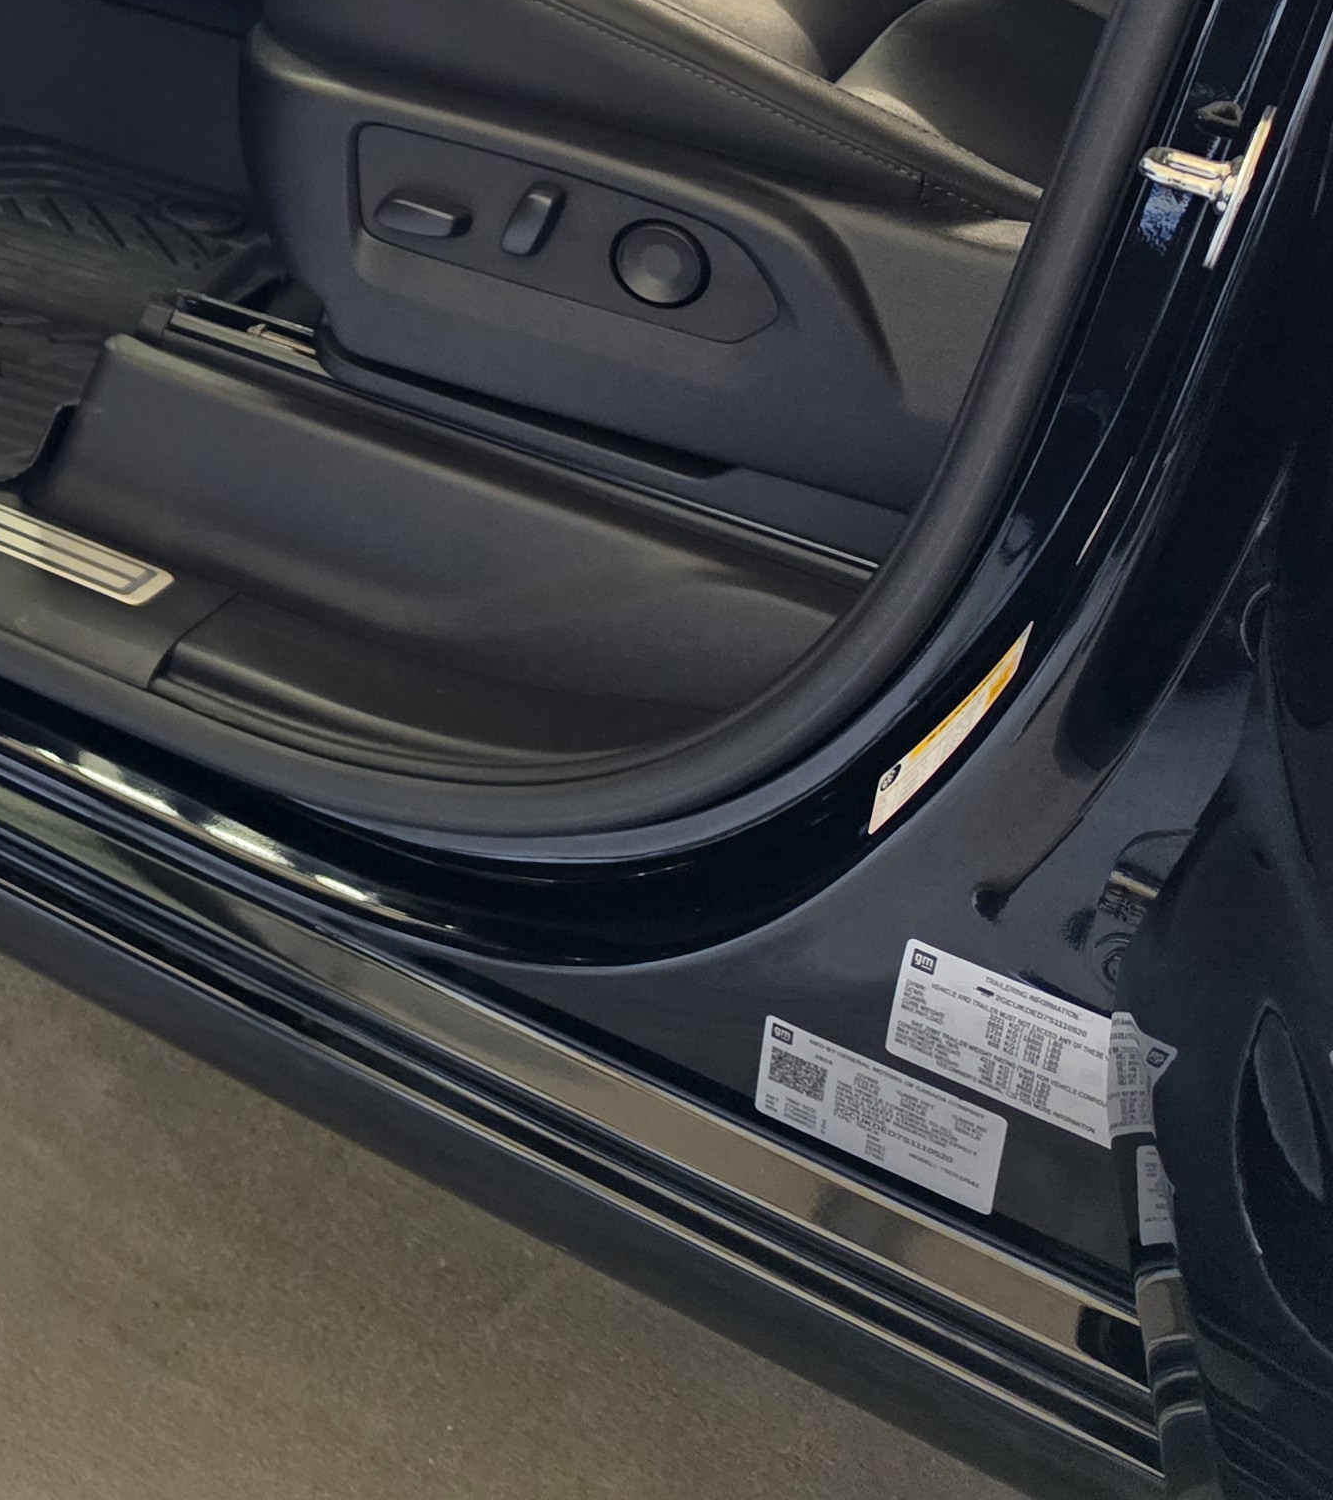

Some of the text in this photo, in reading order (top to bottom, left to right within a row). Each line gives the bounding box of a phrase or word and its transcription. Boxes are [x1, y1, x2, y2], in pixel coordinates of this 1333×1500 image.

[913, 952, 934, 971] gm
[957, 992, 971, 1004] AND
[972, 999, 998, 1015] TRAILER
[984, 975, 1078, 1020] TRAILERING INFORMATION
